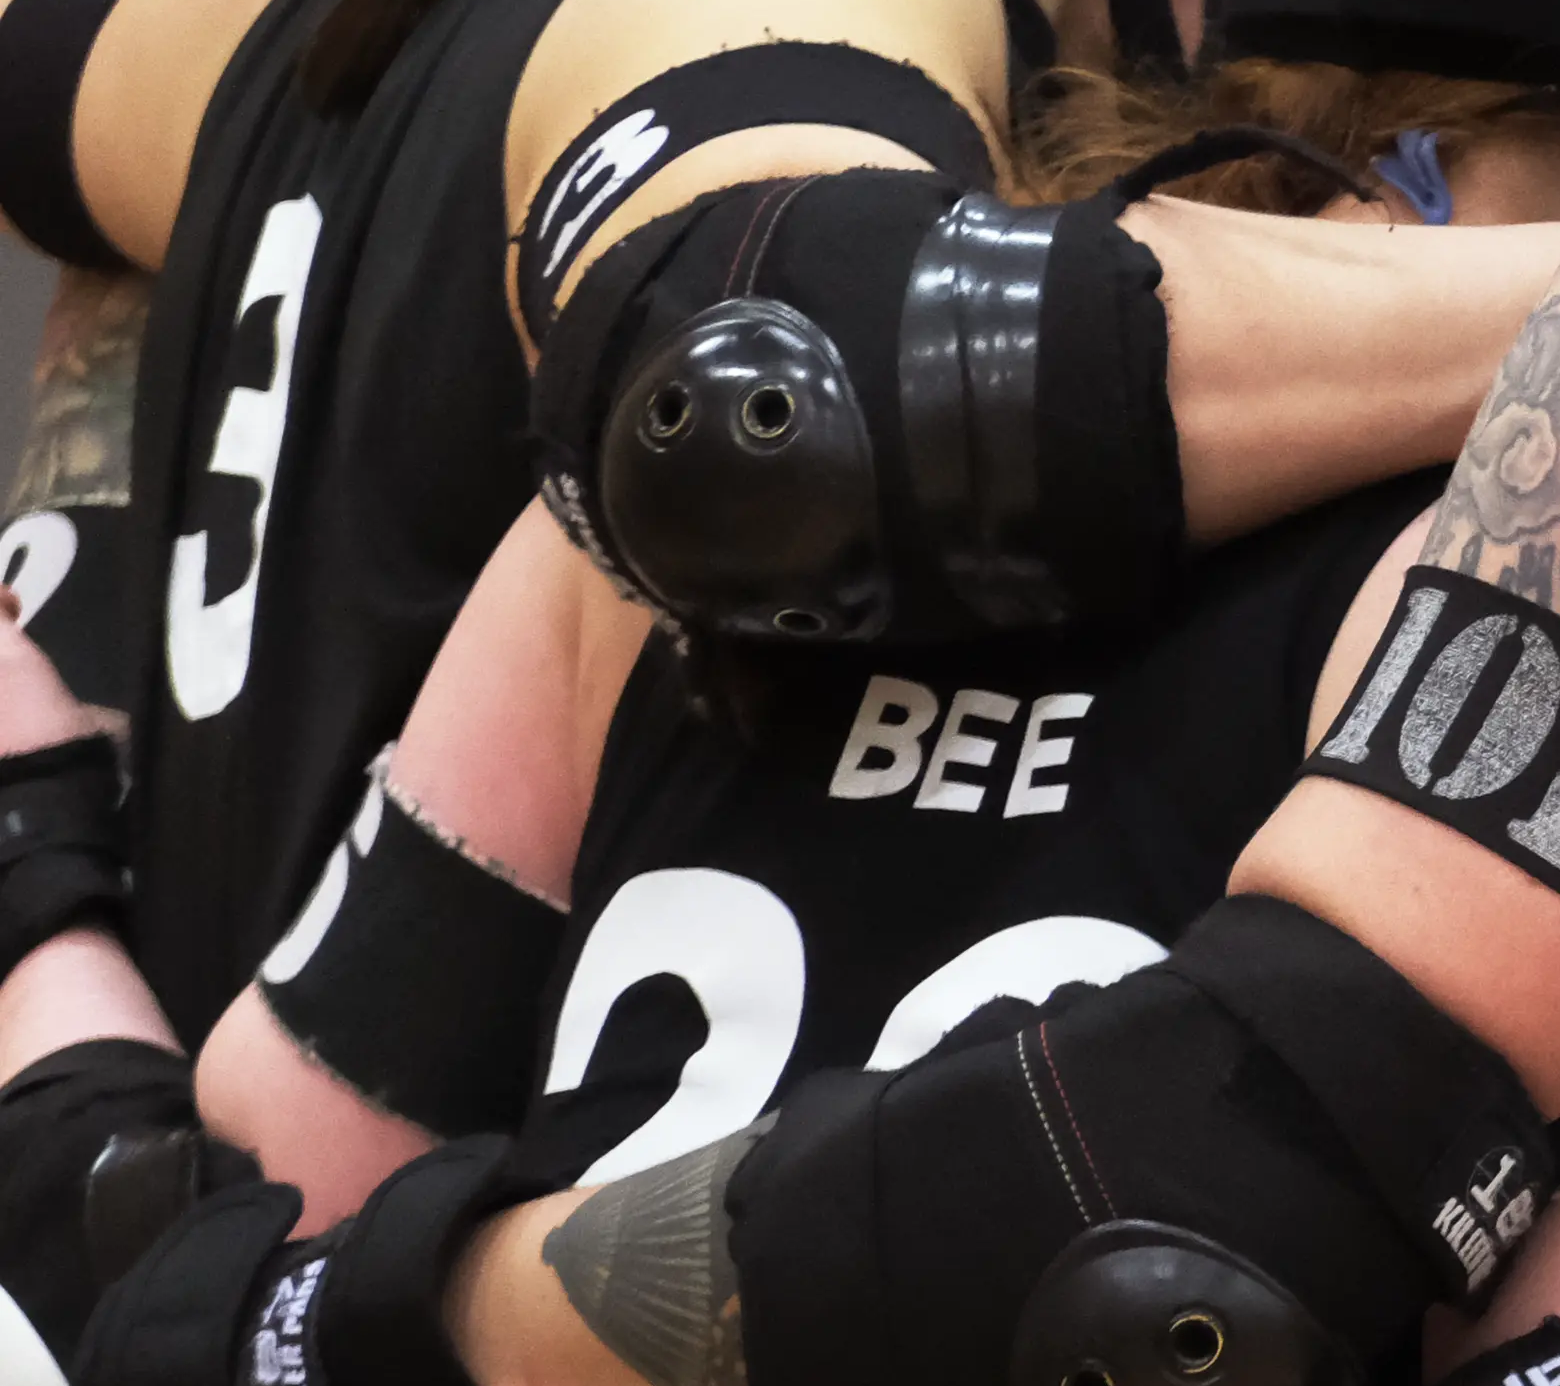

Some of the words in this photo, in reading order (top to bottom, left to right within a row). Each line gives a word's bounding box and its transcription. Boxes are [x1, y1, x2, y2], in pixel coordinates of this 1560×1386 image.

[165, 191, 324, 721] 3
[828, 673, 1096, 819] BEE
[544, 867, 1172, 1189] 2
